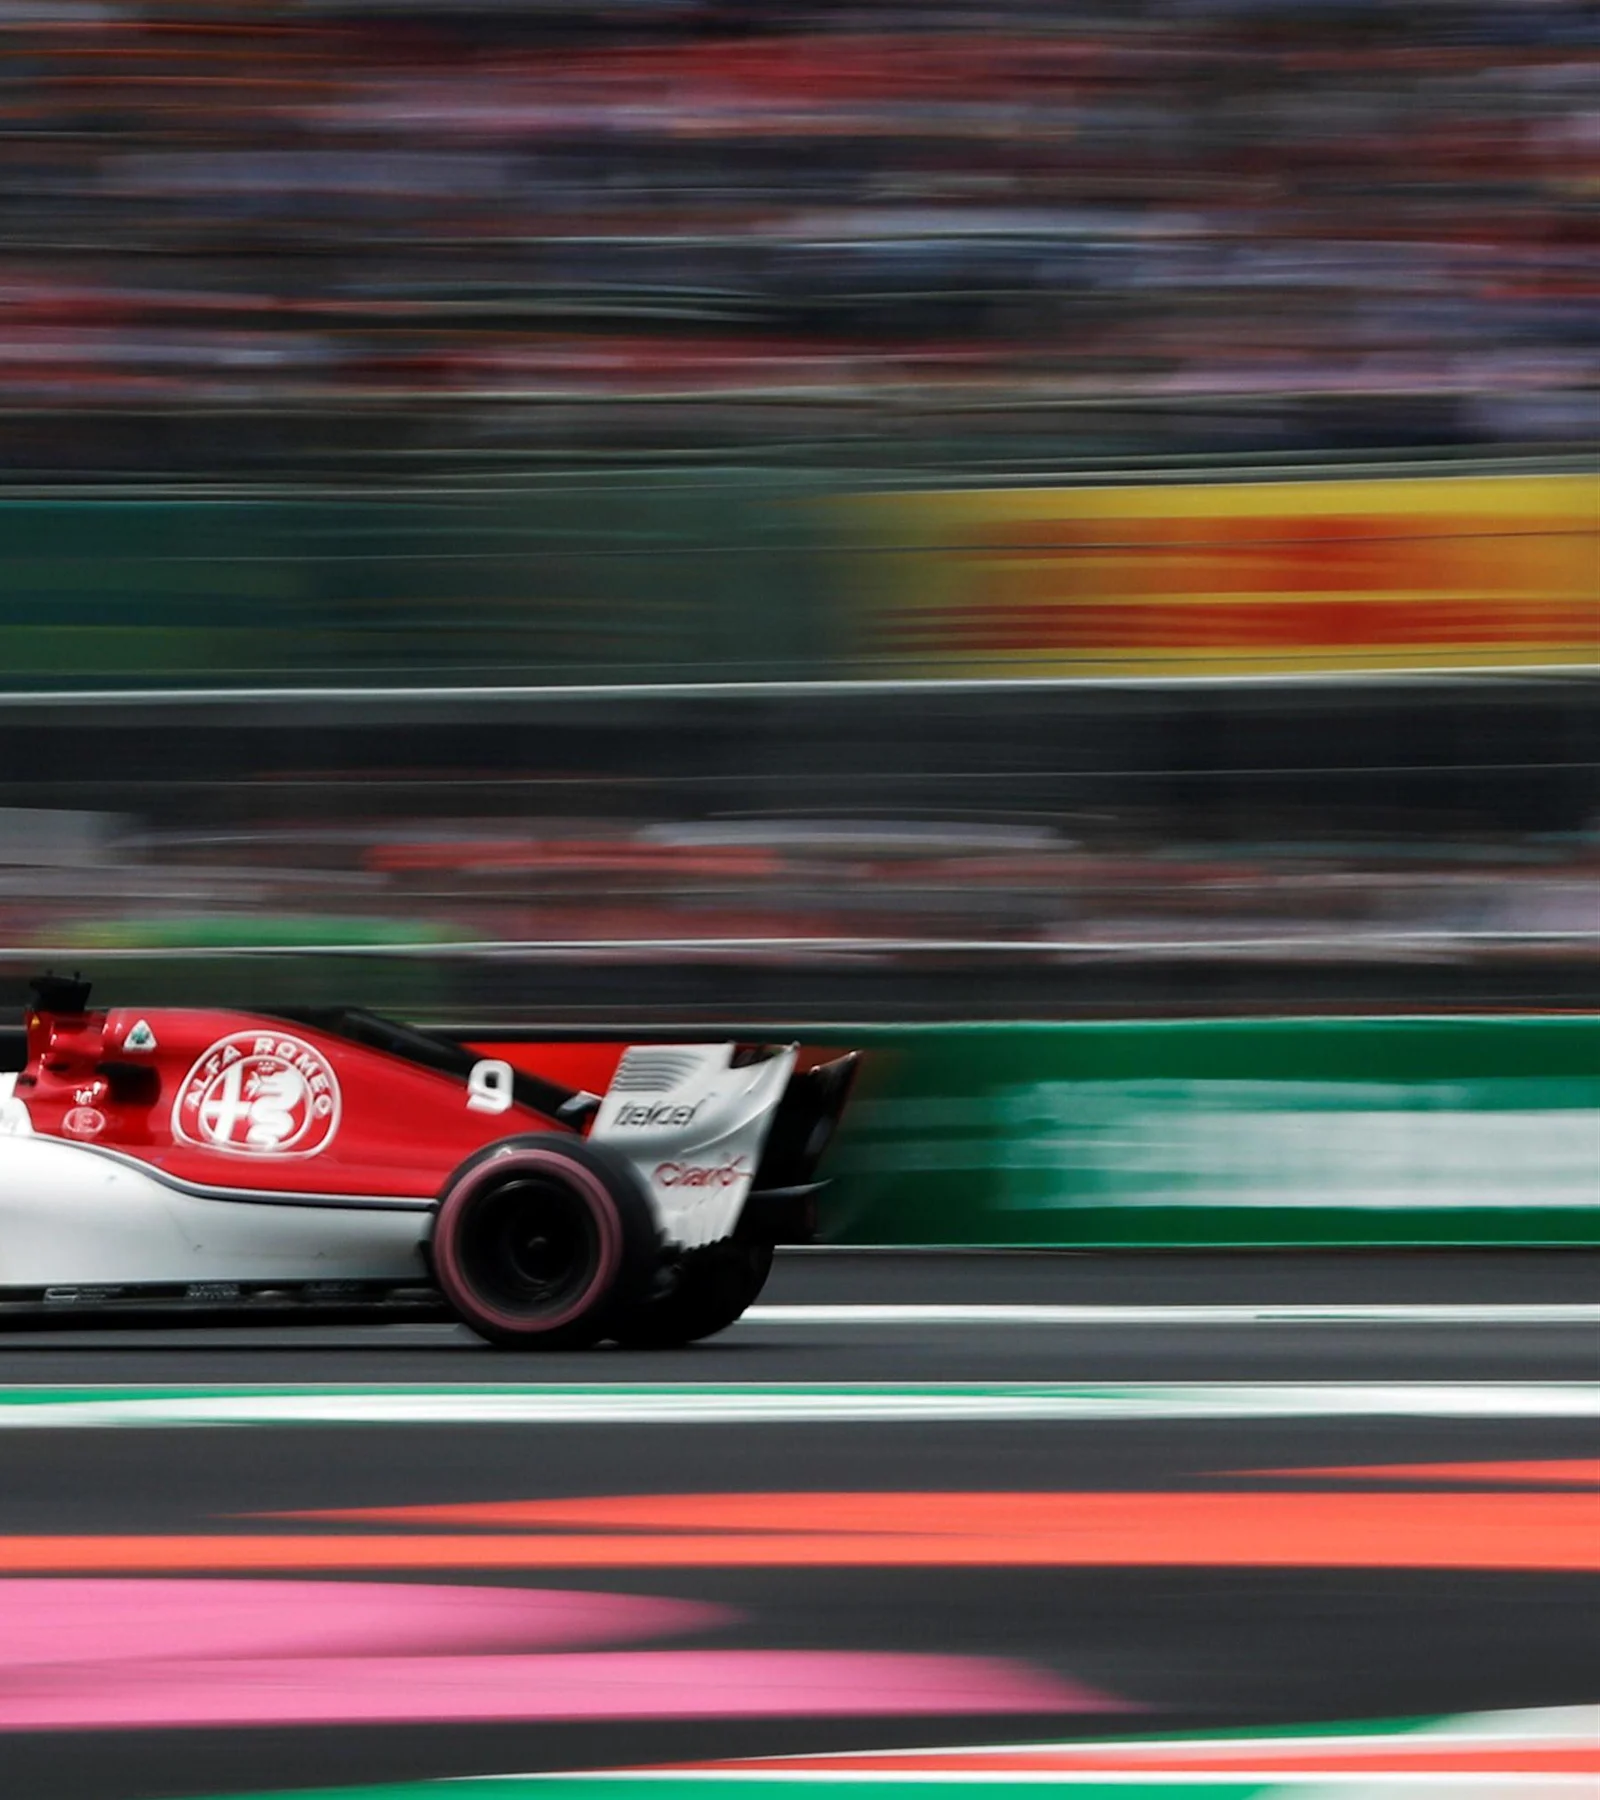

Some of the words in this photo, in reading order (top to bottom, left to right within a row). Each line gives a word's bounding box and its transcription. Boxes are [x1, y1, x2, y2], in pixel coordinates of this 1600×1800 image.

[186, 1044, 242, 1111] ALFA
[253, 1037, 333, 1117] ROMEO
[466, 1059, 514, 1115] 9
[613, 1099, 705, 1127] telcel
[654, 1158, 741, 1187] Claro
